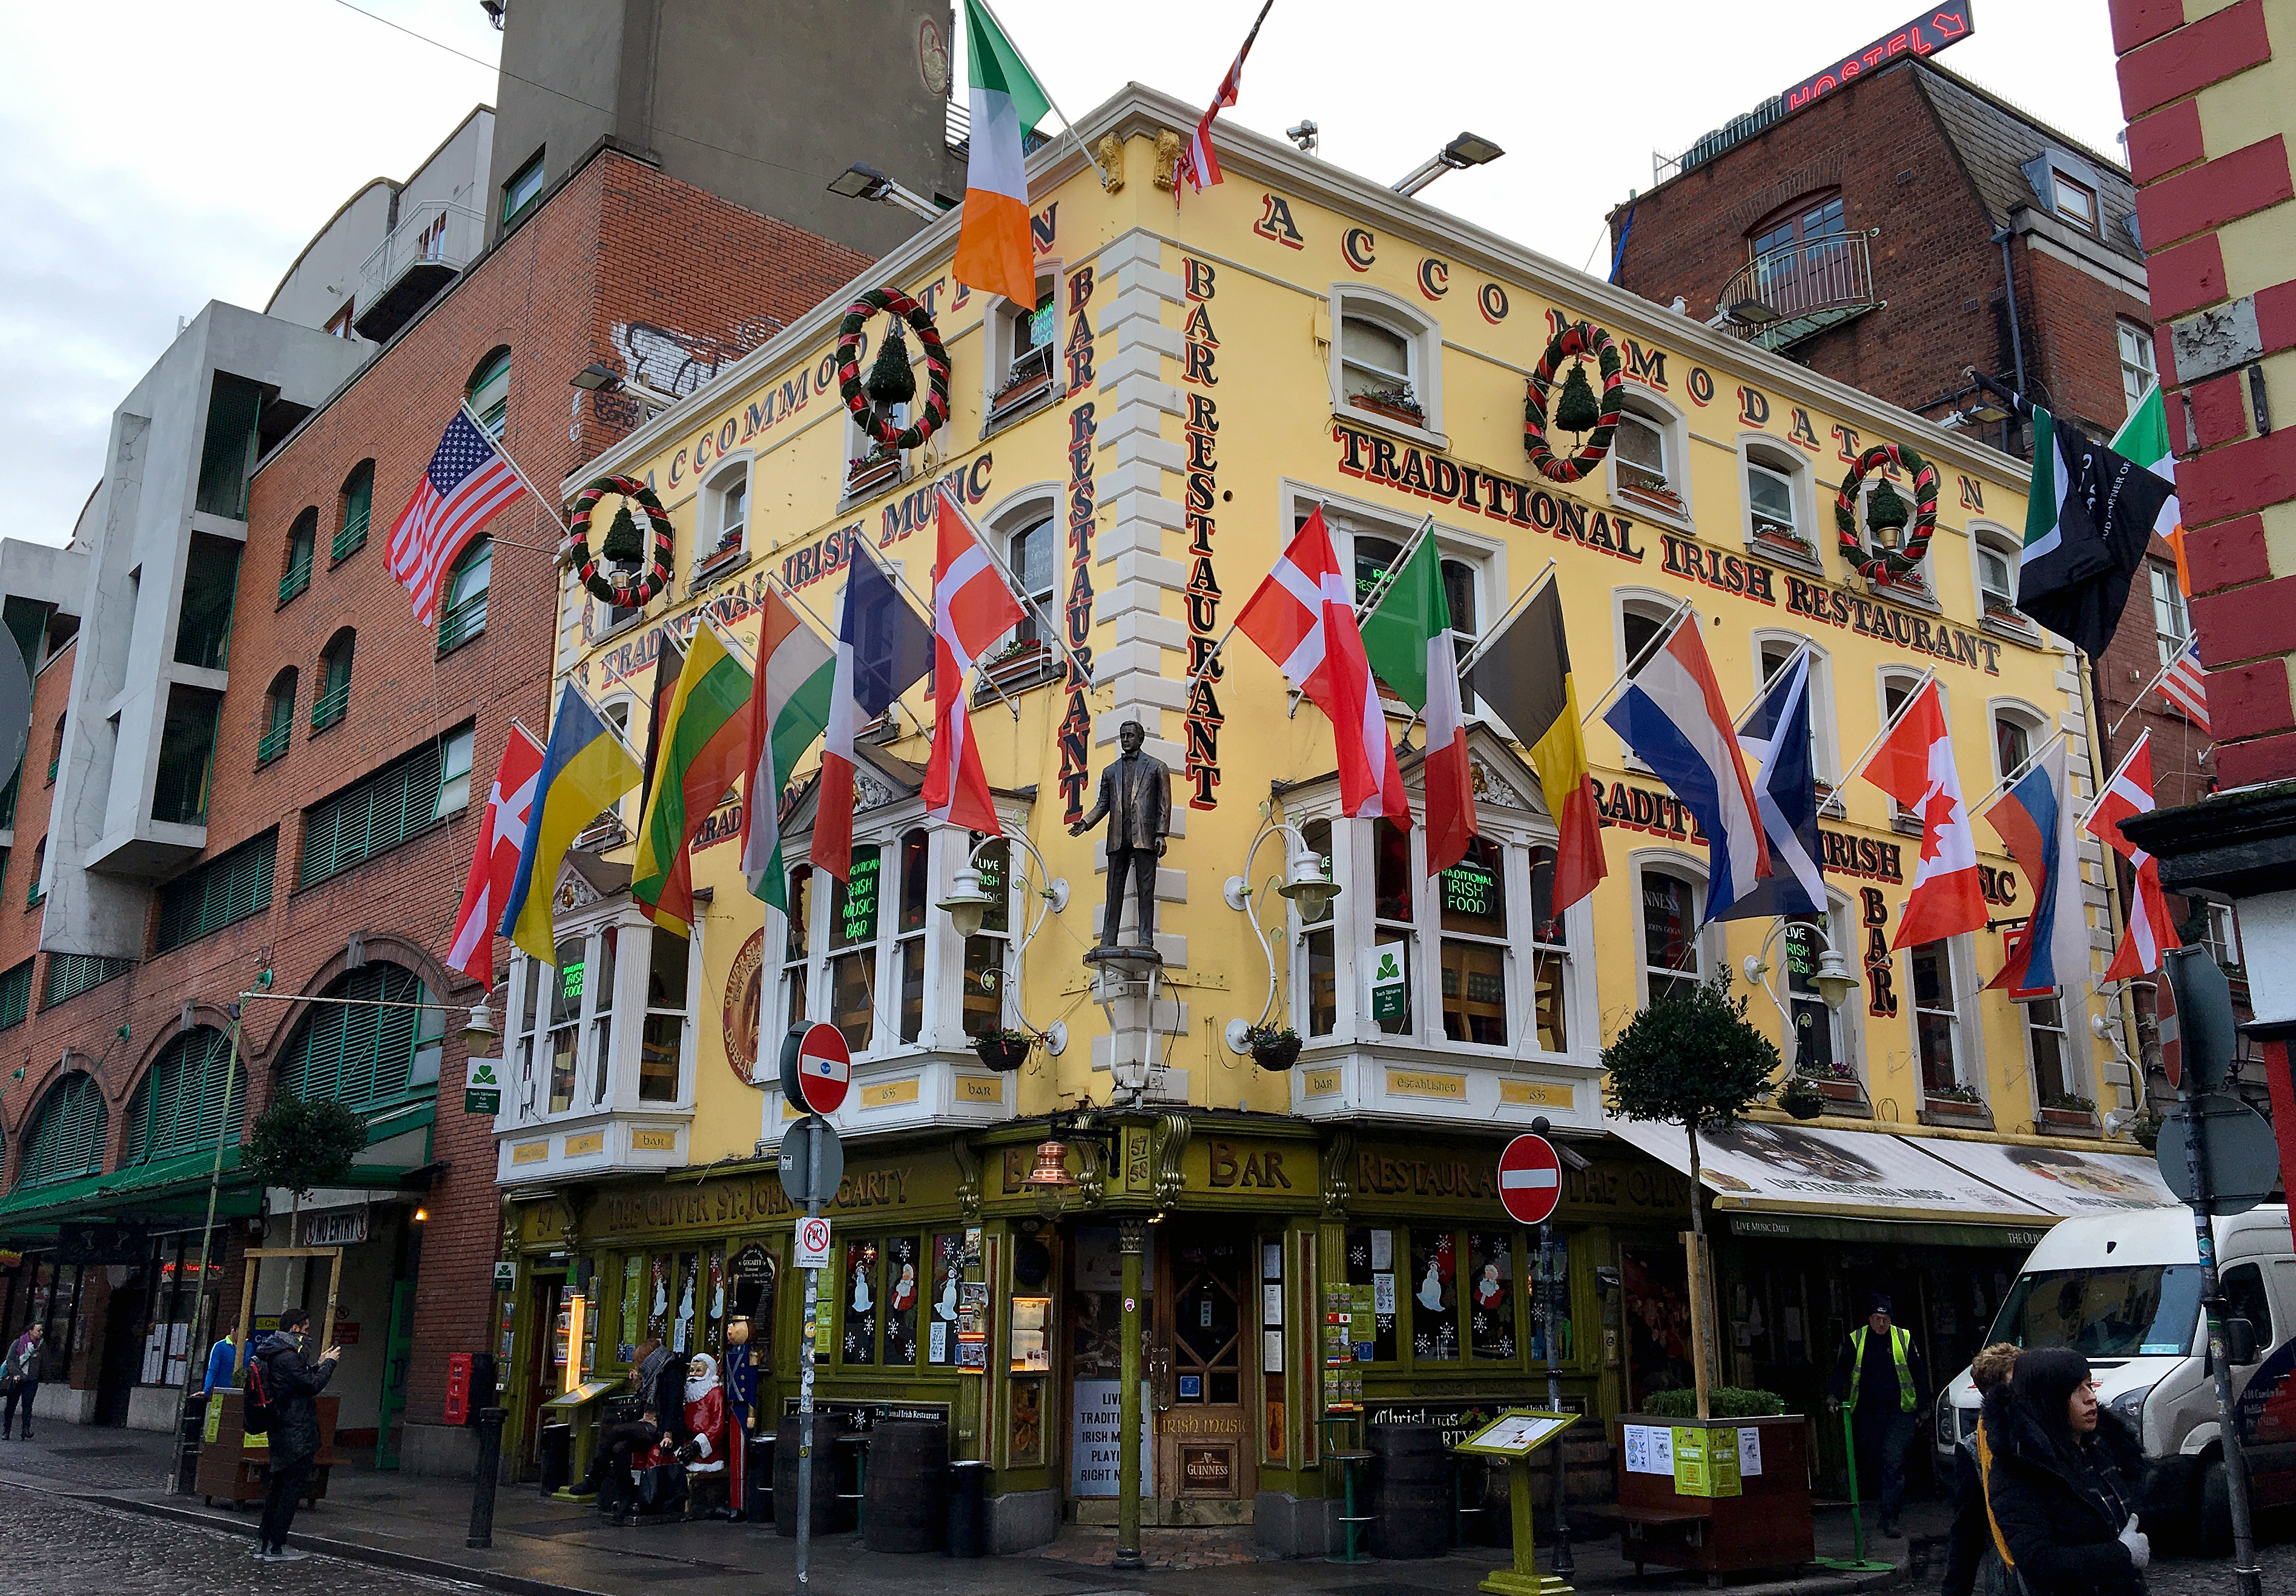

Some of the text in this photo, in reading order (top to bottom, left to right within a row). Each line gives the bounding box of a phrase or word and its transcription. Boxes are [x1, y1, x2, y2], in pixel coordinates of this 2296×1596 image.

[1788, 26, 1933, 111] HOSTEL
[2120, 461, 2131, 475] OF
[1182, 257, 1226, 812] BAR RESTAURANT
[1058, 266, 1098, 825] BAR RESTAURANT
[1333, 424, 2002, 677] TRADITIONAL IRISH RESTAURANT
[978, 857, 999, 871] LIVE
[980, 875, 1000, 886] RISH
[1441, 868, 1494, 887] RADITIONAL
[1448, 879, 1484, 898] IRISH
[1448, 895, 1486, 914] FOOD
[1643, 889, 1679, 911] NNESS
[1784, 926, 1806, 940] LIVE
[1786, 942, 1810, 957] RISH
[1859, 886, 1898, 1020] BAR
[725, 955, 747, 1009] OLIVER
[1130, 1135, 1148, 1156] 57
[1129, 1162, 1149, 1183] 58
[1207, 1141, 1292, 1189] BAR
[645, 1190, 710, 1227] OLIVER
[317, 1213, 357, 1242] NO ENTRY
[2007, 1233, 2023, 1244] THE
[1081, 1431, 1108, 1443] IRISH
[1081, 1469, 1110, 1482] RIGHT
[1187, 1463, 1229, 1476] GUINNESS
